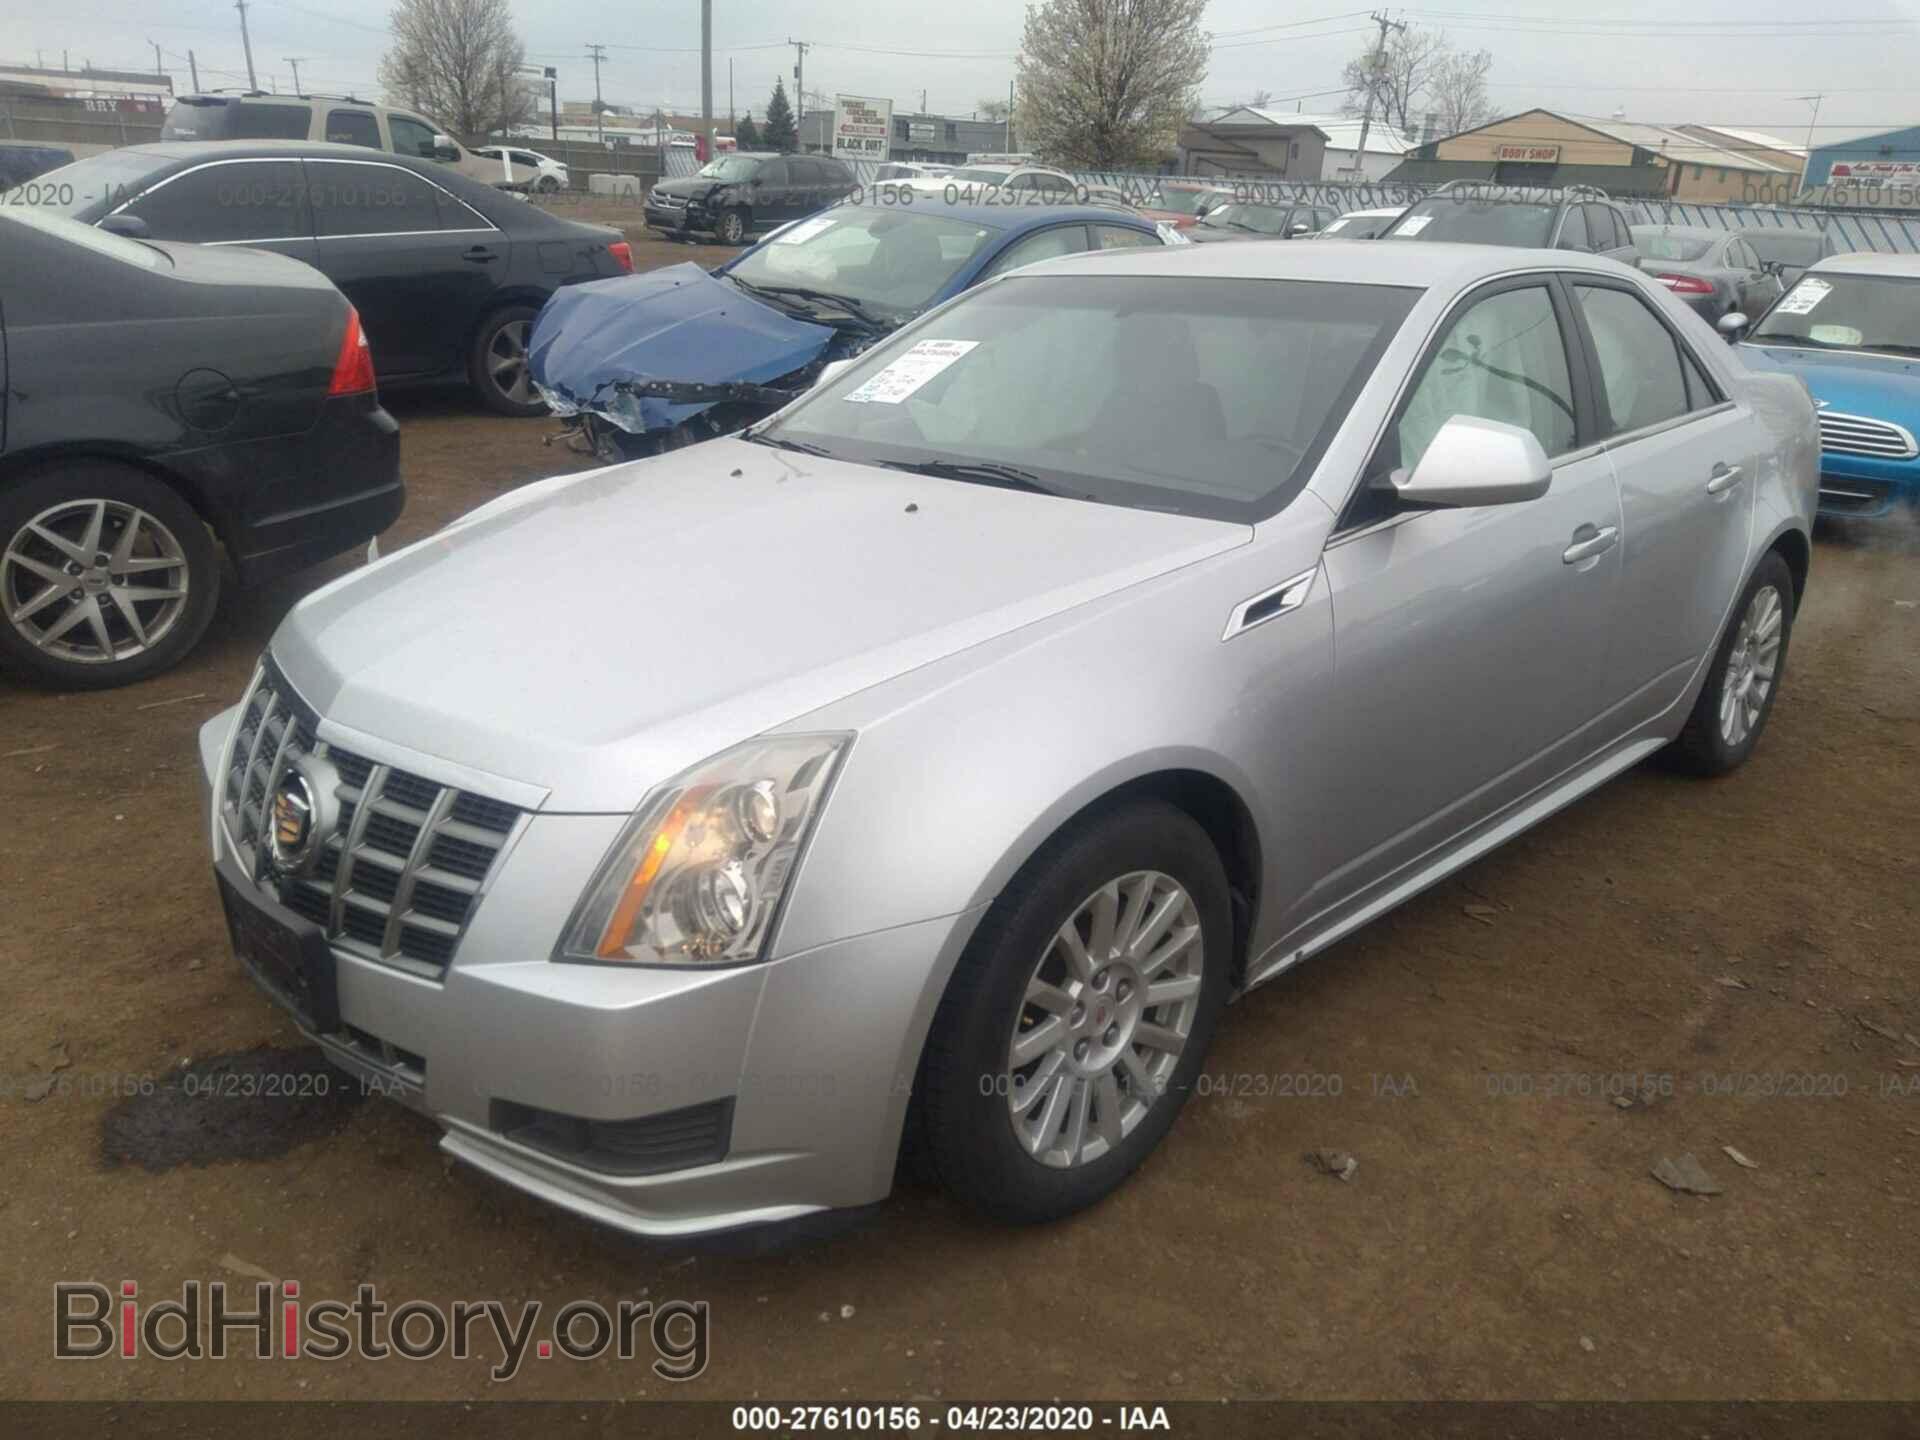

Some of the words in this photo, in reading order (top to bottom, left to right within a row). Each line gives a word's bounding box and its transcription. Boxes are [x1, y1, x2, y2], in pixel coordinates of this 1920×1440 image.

[836, 138, 861, 150] BLACK
[865, 139, 882, 151] DIRT
[1502, 148, 1526, 158] BODY
[1528, 148, 1555, 160] SHOP
